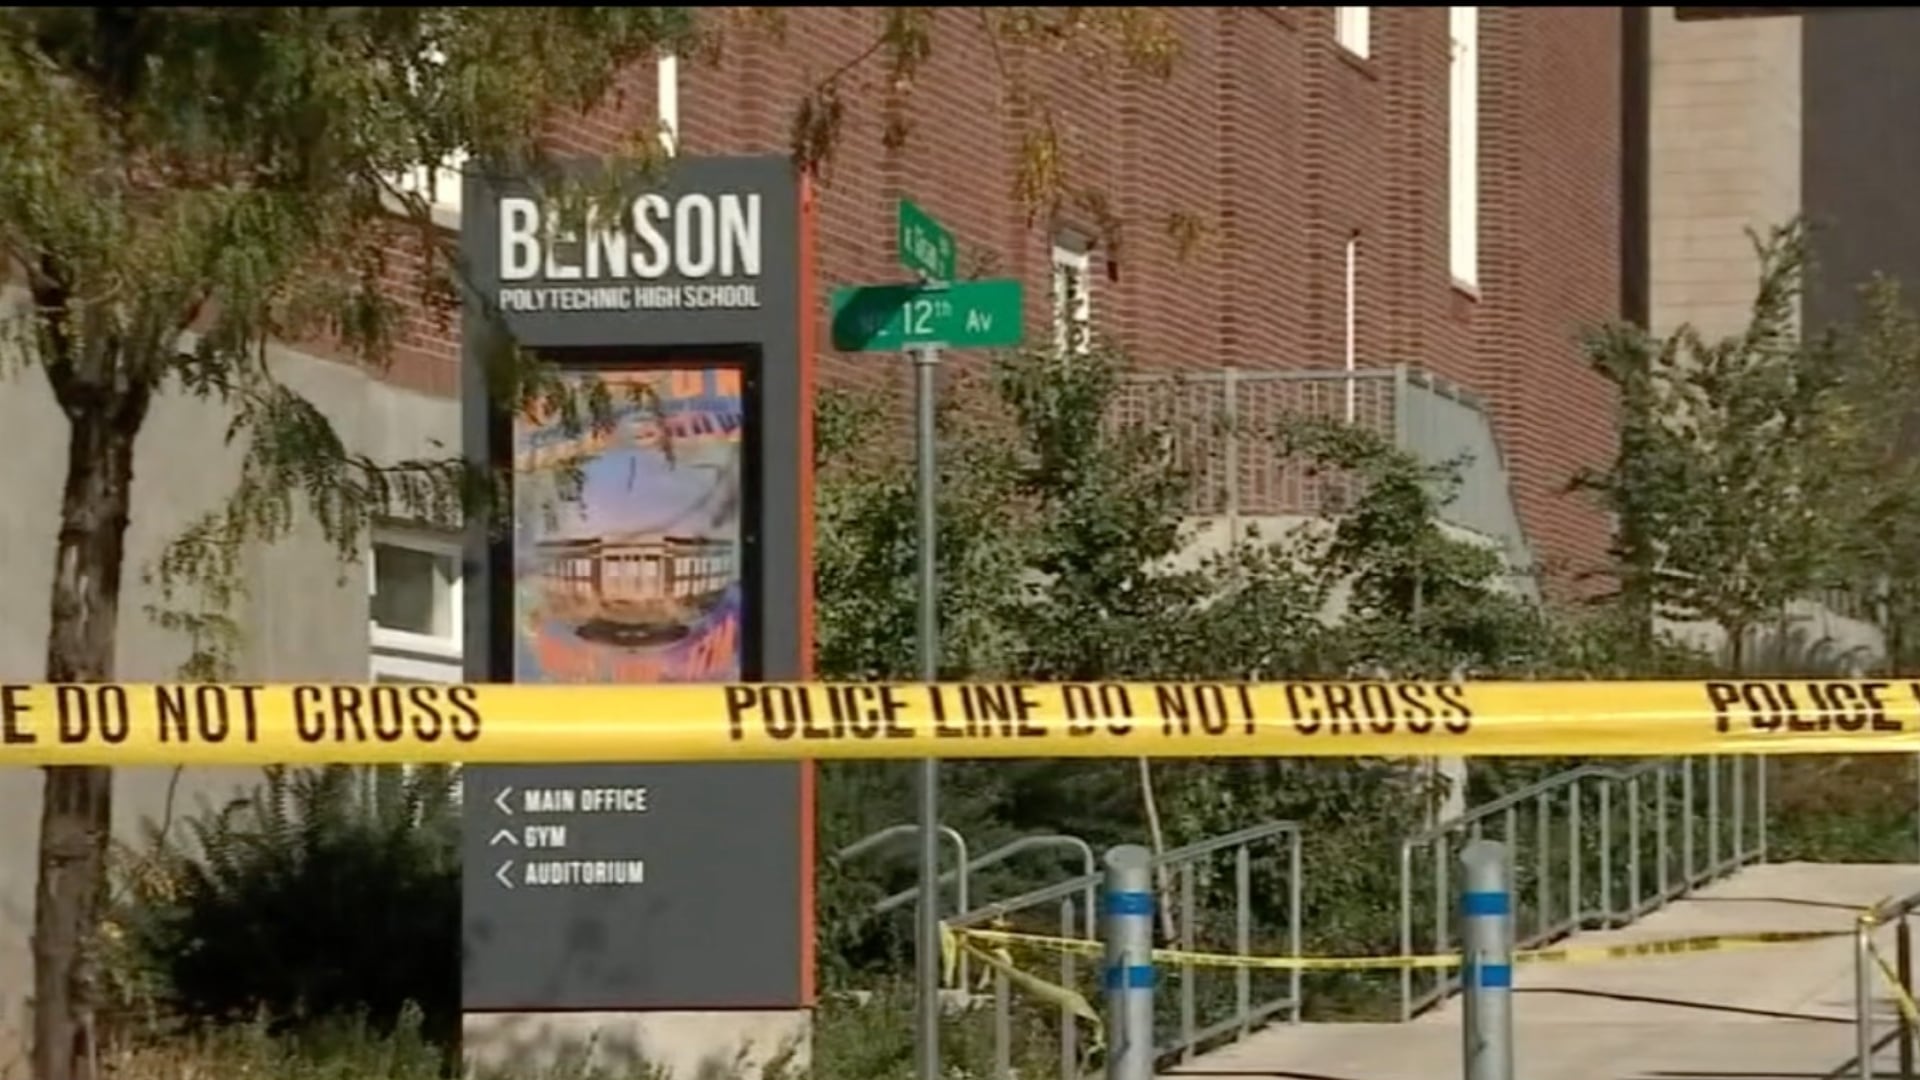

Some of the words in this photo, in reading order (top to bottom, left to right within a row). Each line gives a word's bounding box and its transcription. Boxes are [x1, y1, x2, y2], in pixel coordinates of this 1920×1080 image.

[500, 194, 761, 279] BENSON
[501, 288, 631, 311] POLYTECHNIC
[634, 287, 681, 309] HIGH
[684, 285, 760, 308] SCHOOL
[965, 308, 992, 333] Av
[57, 685, 129, 743] DO
[156, 684, 264, 743] NOT
[293, 685, 481, 742] CROSS
[724, 685, 917, 741] POLICE
[927, 684, 1048, 738] LINE
[1062, 684, 1134, 737] DO
[1157, 684, 1256, 736] NOT
[1286, 683, 1473, 736] CROSS
[1705, 682, 1904, 733] POLICE
[524, 789, 575, 812] MAIN
[580, 788, 648, 811] OFFICE
[524, 825, 567, 848] GYM
[524, 861, 645, 885] AUDITORIUM
